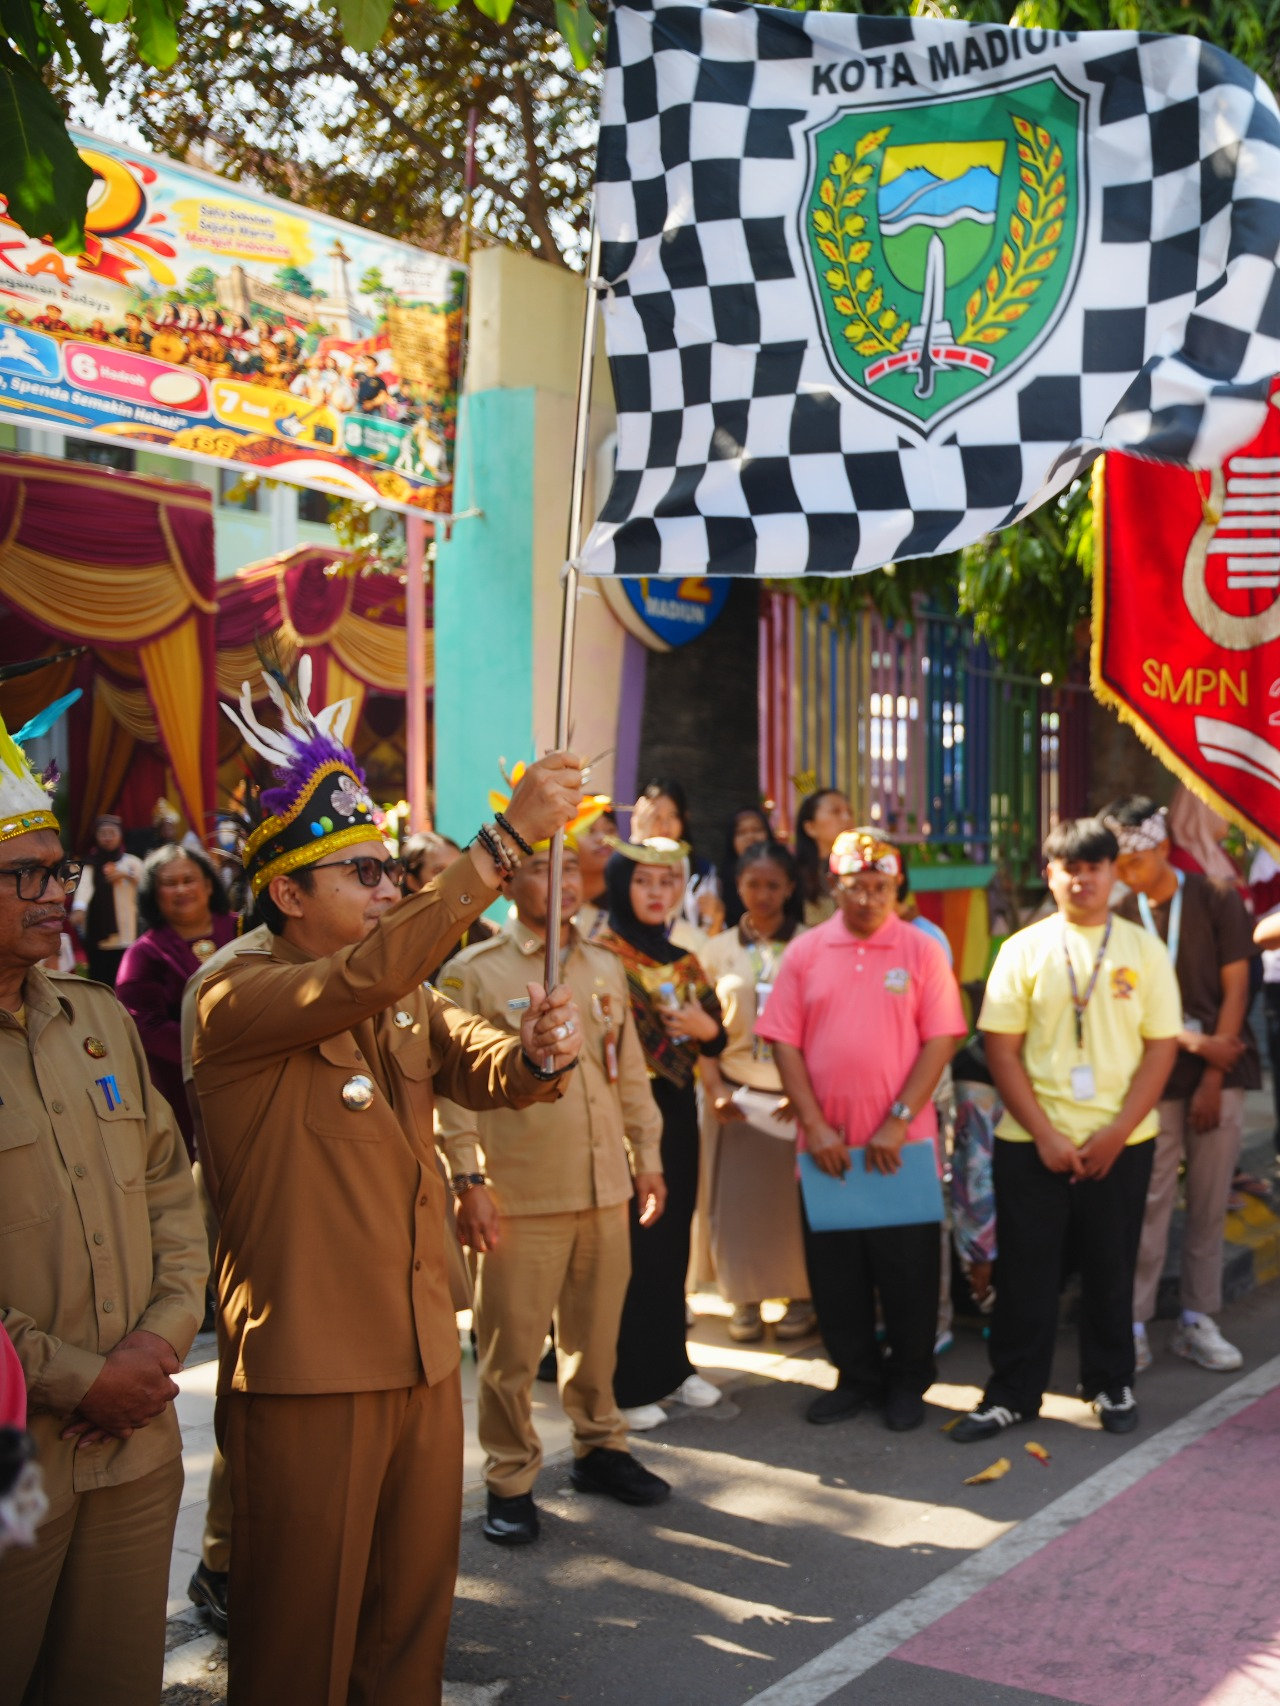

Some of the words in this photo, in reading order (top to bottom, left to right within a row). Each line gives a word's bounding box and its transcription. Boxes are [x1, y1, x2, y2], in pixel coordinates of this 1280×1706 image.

[811, 52, 918, 96] KOTA
[71, 353, 99, 381] 6
[10, 376, 70, 402] Spenda
[71, 391, 134, 419] Semakin
[218, 388, 239, 412] 7
[1142, 659, 1249, 708] SMPN
